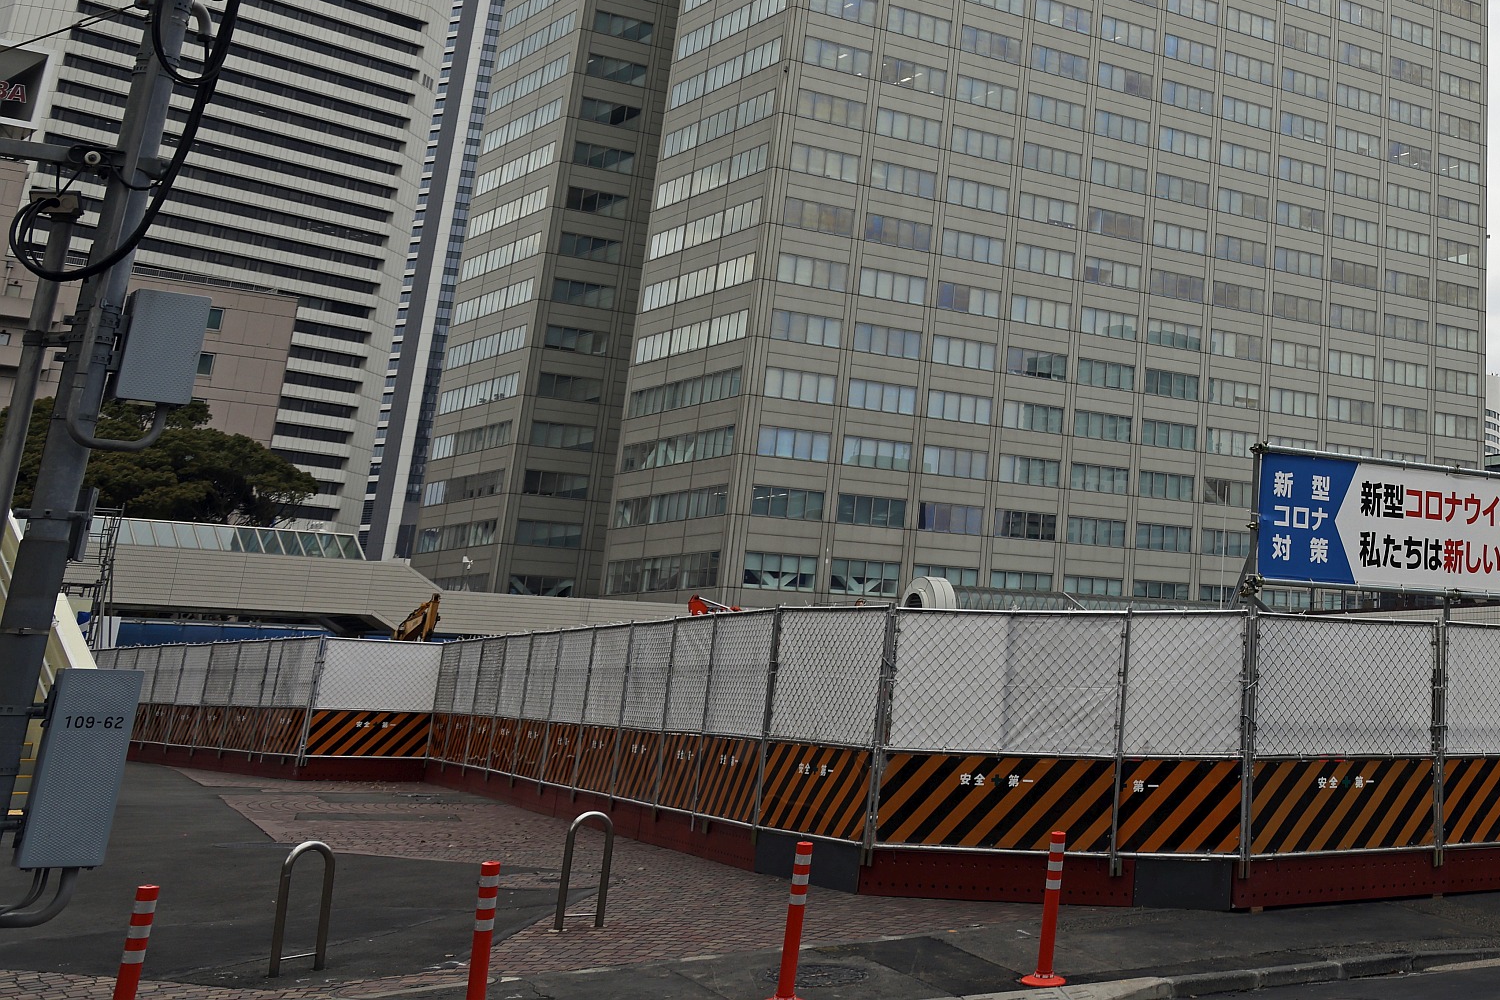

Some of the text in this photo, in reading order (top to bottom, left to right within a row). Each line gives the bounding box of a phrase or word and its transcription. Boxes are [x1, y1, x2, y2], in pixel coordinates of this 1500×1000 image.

[1273, 505, 1329, 531] コロナ
[65, 715, 125, 729] 109-62
